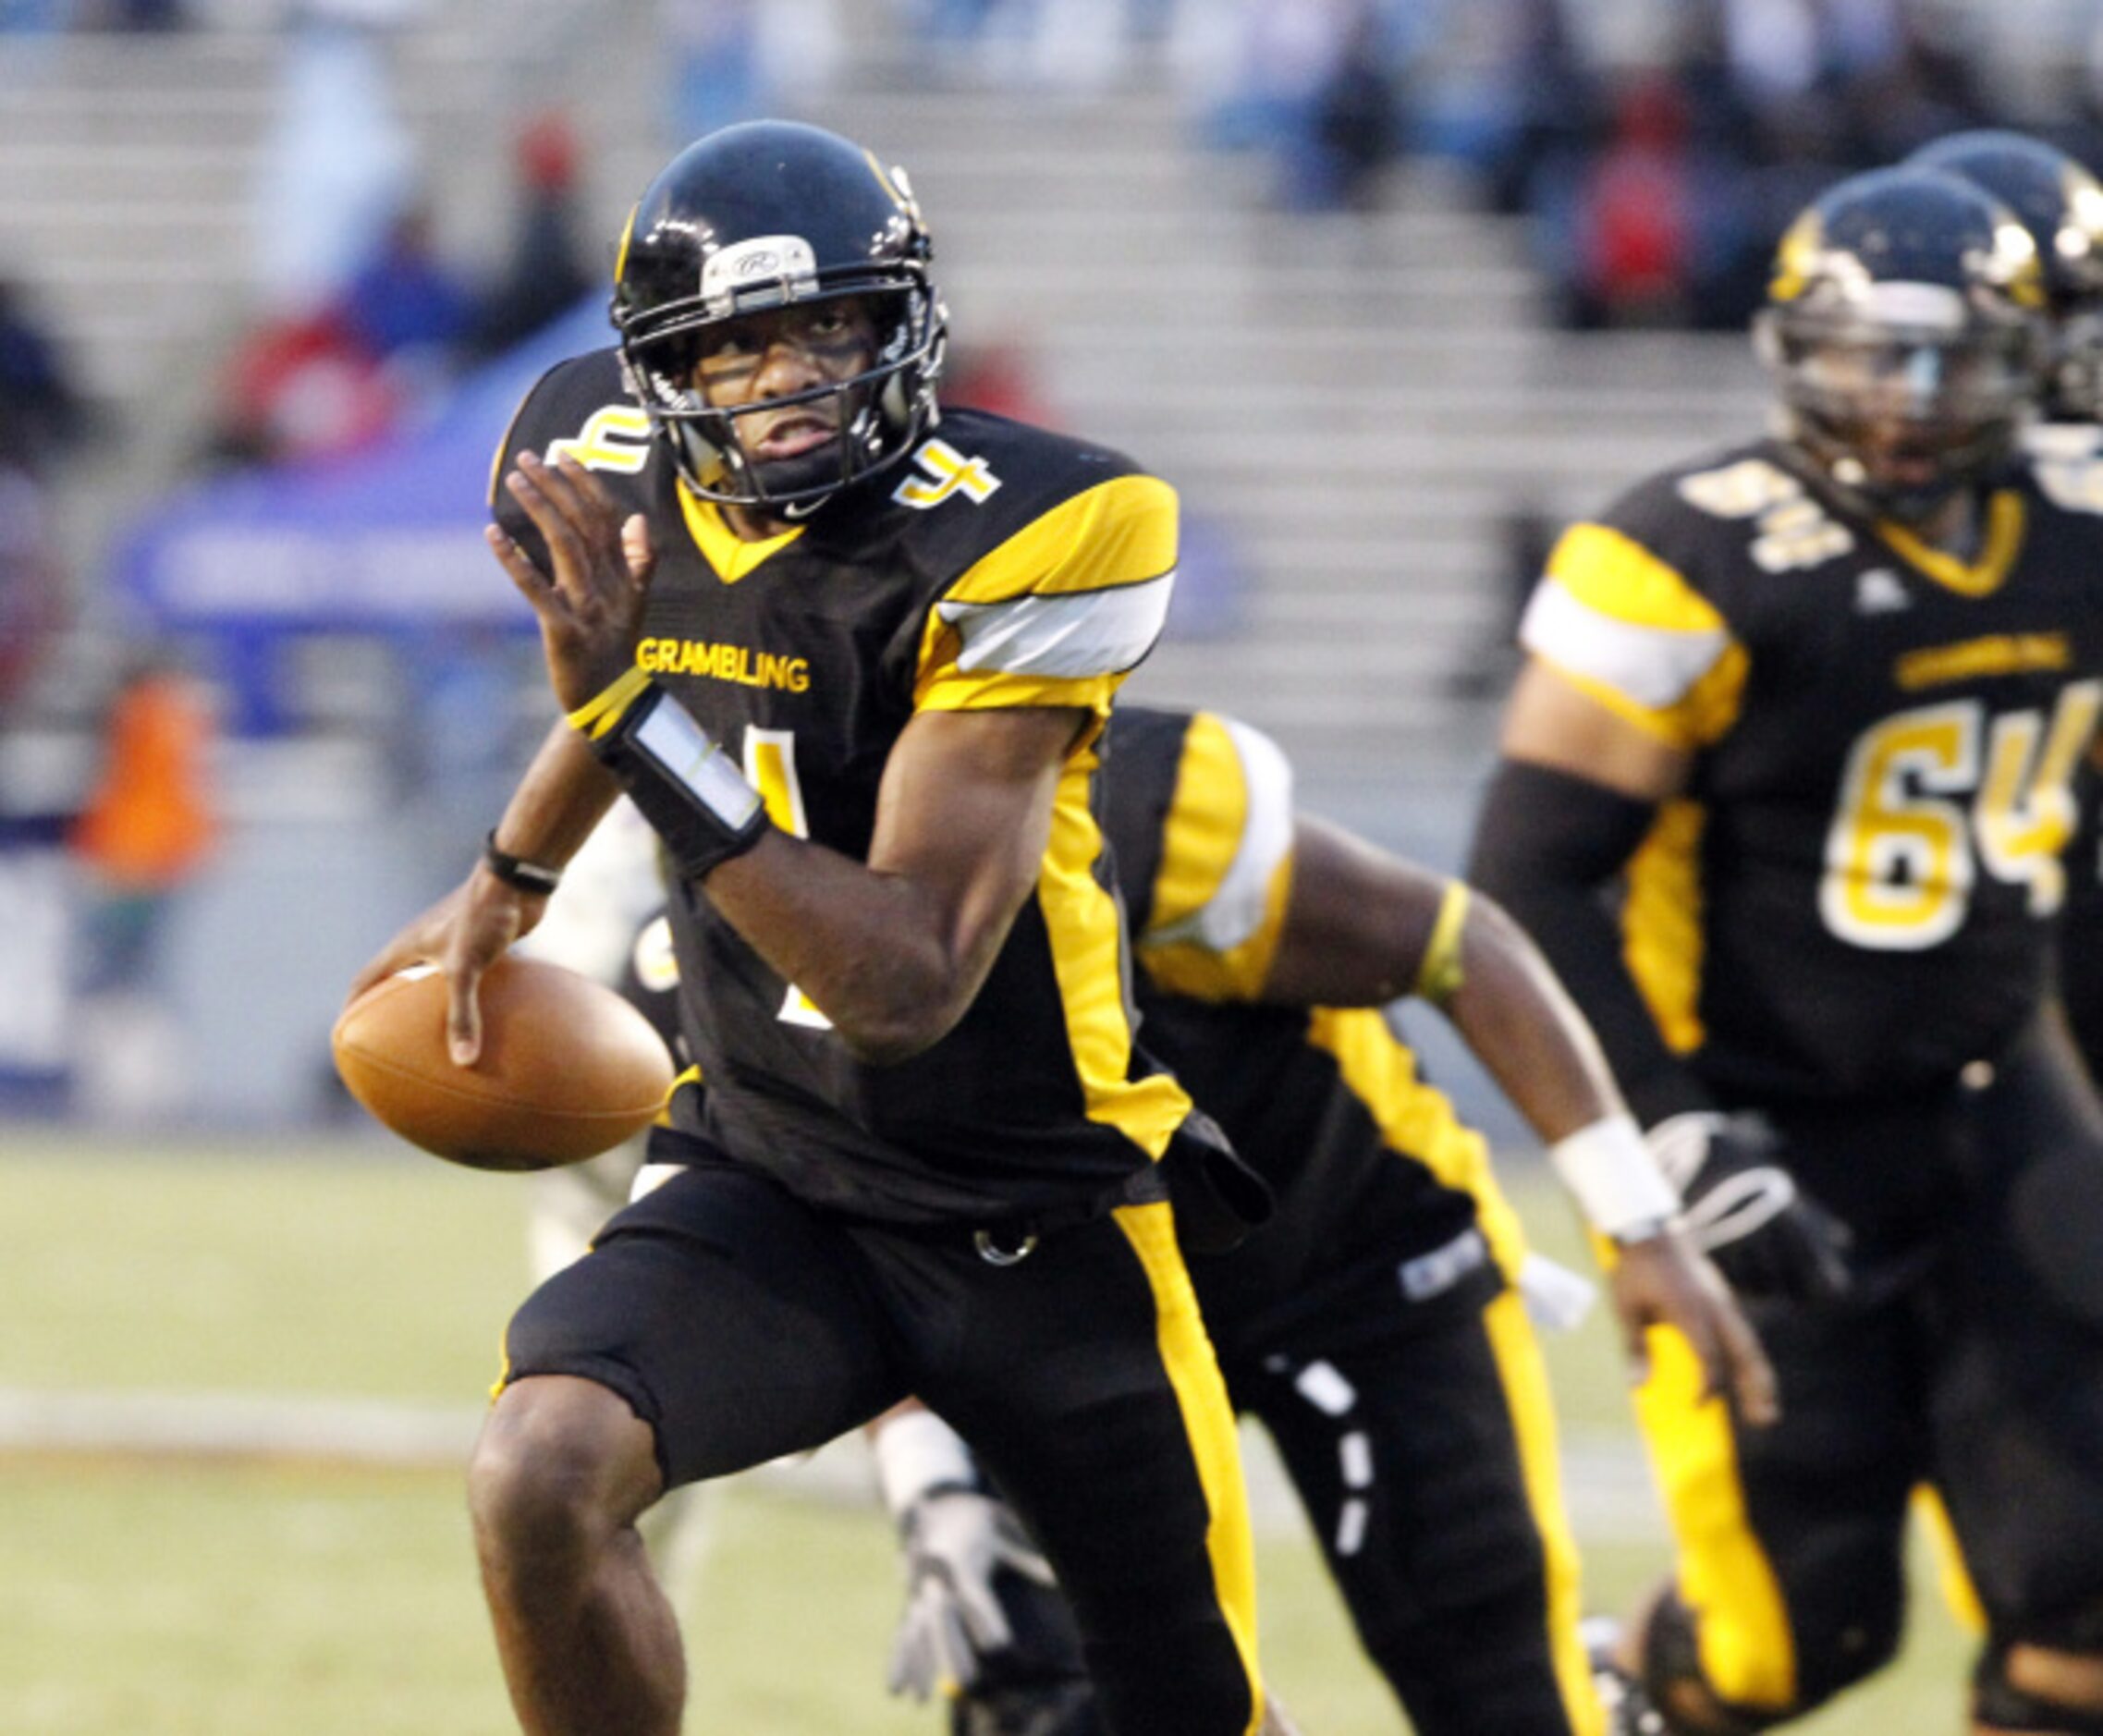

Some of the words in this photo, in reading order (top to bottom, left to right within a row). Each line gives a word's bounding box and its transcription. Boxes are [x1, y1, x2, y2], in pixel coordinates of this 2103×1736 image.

[890, 437, 1003, 509] 4
[636, 636, 810, 693] GRAMBLING
[1818, 678, 2103, 951] 64
